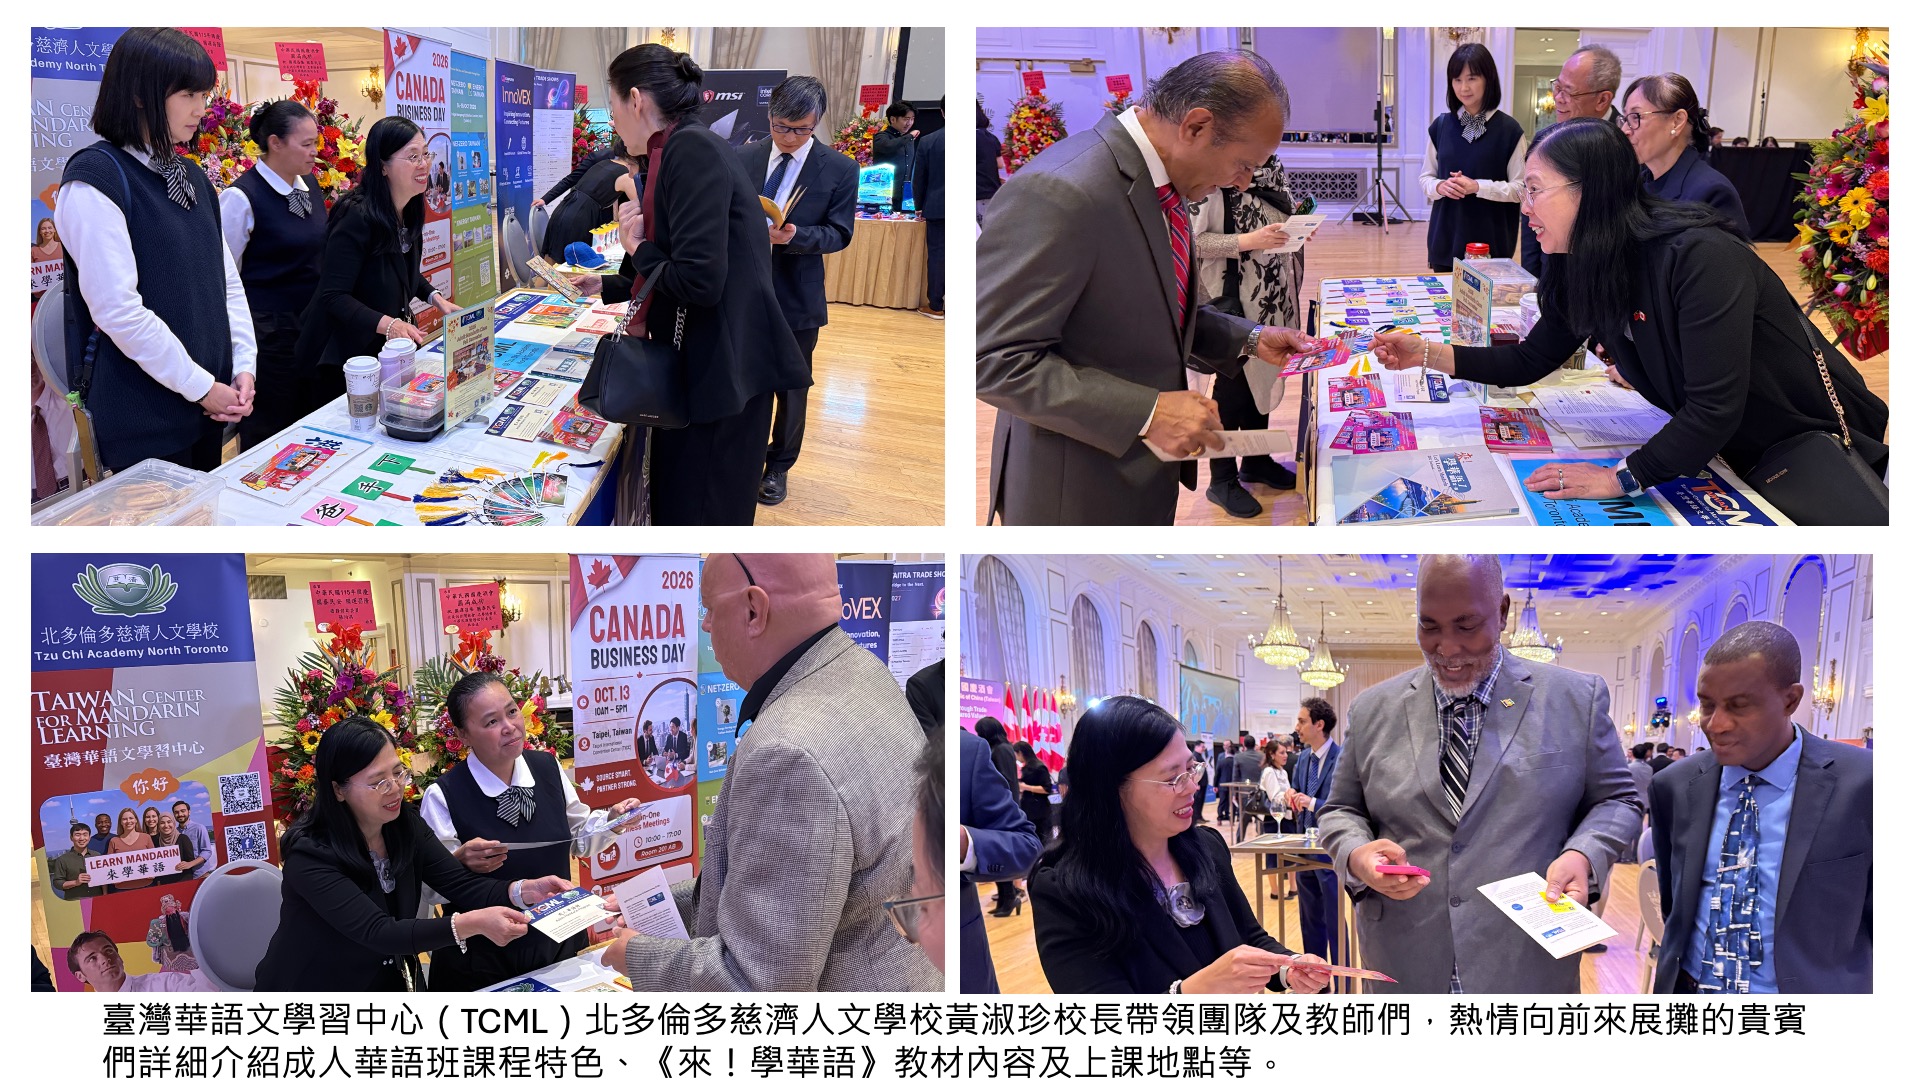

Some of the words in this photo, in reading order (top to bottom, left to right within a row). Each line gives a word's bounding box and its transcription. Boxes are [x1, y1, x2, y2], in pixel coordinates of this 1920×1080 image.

[65, 61, 97, 72] North
[432, 52, 449, 69] 2026
[395, 70, 446, 104] CANADA
[502, 86, 531, 105] InnoVEX
[715, 92, 743, 100] msi
[397, 103, 432, 121] BUSINESS
[433, 107, 446, 122] DAY
[32, 133, 72, 148] ING
[662, 570, 694, 589] 2026
[589, 604, 685, 643] CANADA
[41, 622, 220, 646] 北多倫多慈濟人文學校
[34, 651, 59, 661] Tzu
[62, 650, 84, 660] Chi
[87, 647, 144, 660] Academy
[148, 645, 182, 656] North
[184, 644, 229, 655] Toronto
[591, 645, 658, 669] BUSINESS
[662, 643, 685, 663] DAY
[31, 688, 135, 712] TAIWAN
[142, 689, 208, 705] CENTER
[594, 686, 617, 703] OCT.
[620, 685, 630, 700] 13
[35, 714, 76, 729] FOR
[76, 702, 201, 726] MANDARIN
[595, 706, 608, 716] 10AM
[615, 704, 628, 713] 5PM
[40, 720, 156, 745] LEARNING
[592, 729, 612, 740] Taipei,
[612, 728, 632, 737] Taiwan
[43, 741, 205, 770] 臺灣華語文學習中心
[596, 772, 615, 782] SOURCE
[615, 769, 631, 779] SMART.
[132, 777, 169, 795] 你好
[596, 783, 617, 793] PARTNER
[617, 780, 637, 789] STRONG.
[642, 817, 670, 829] Meetings
[645, 835, 661, 843] 10:00
[666, 830, 682, 838] 17:00
[90, 856, 124, 870] LEARN
[125, 848, 179, 866] MANDARIN
[641, 848, 657, 857] Room
[106, 862, 166, 881] 來學華語
[531, 898, 564, 914] TCML
